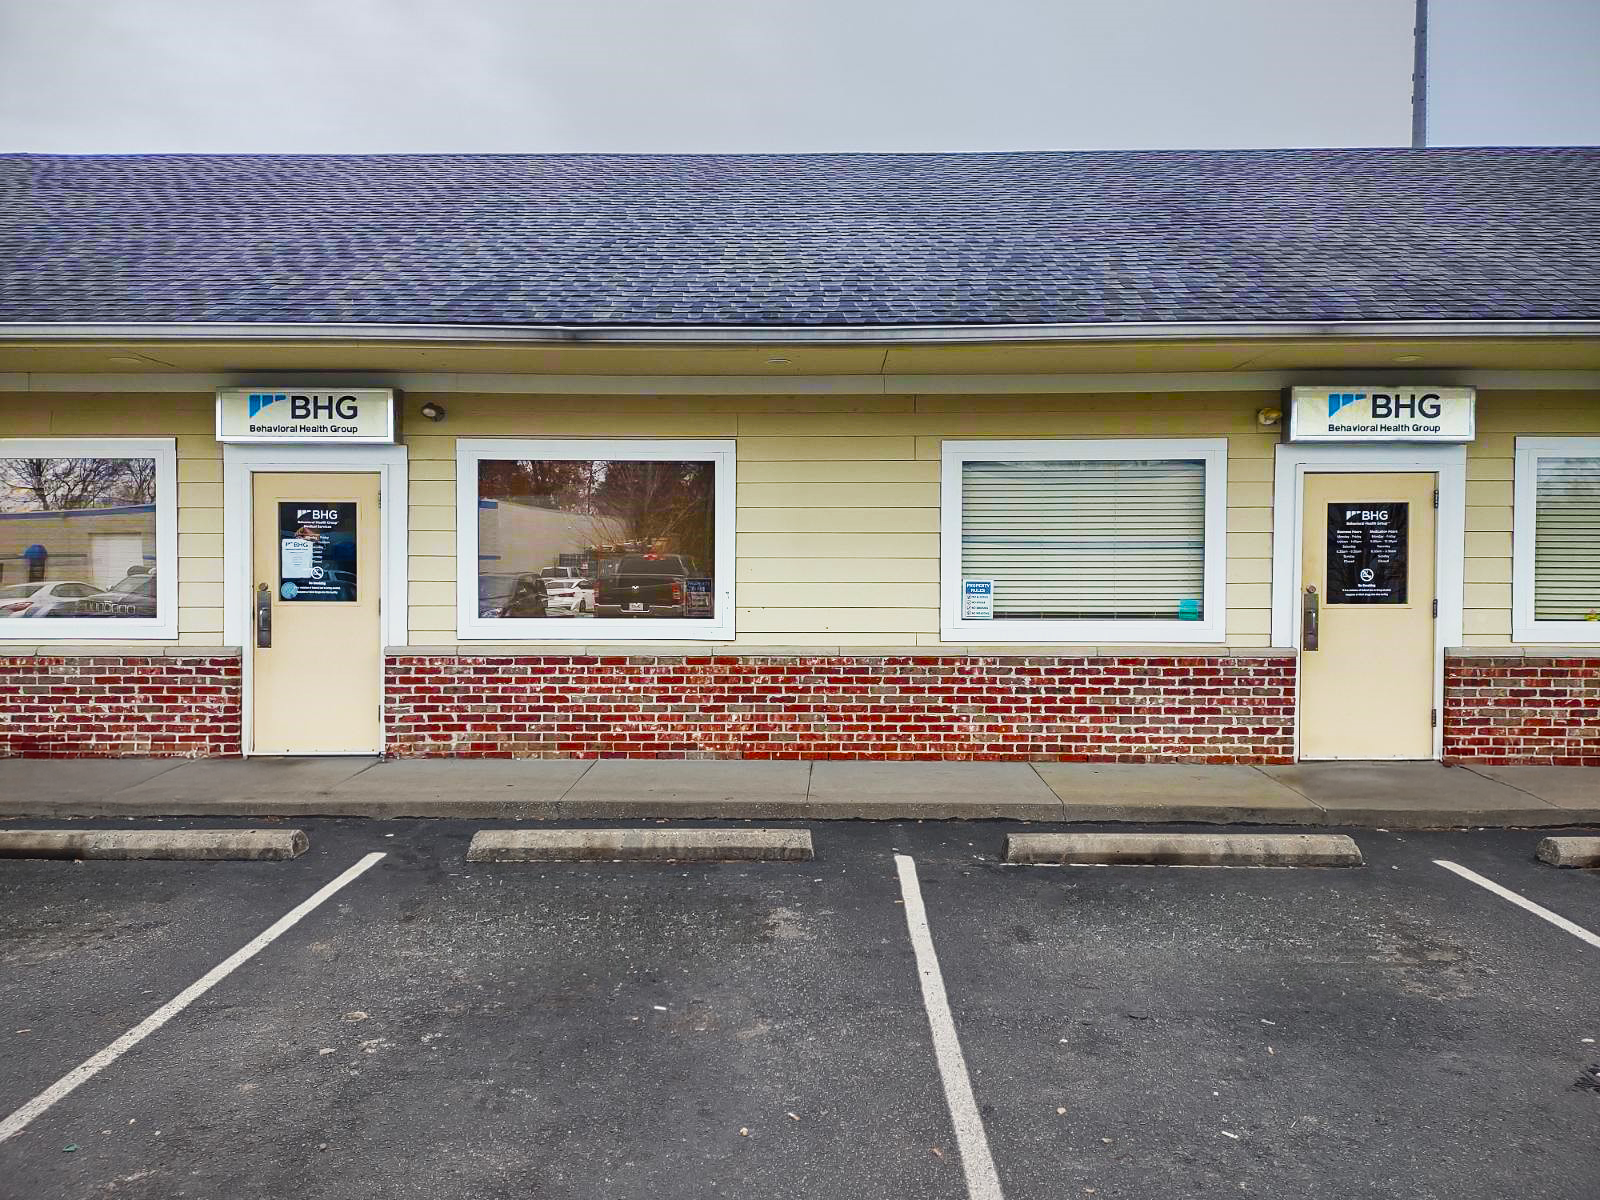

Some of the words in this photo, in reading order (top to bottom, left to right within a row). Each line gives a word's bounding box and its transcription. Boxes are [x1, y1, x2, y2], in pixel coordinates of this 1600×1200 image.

[291, 395, 359, 420] BHG
[1371, 393, 1442, 419] BHG
[249, 424, 298, 433] Behavioral
[300, 424, 329, 433] Health
[330, 424, 358, 434] Group
[1328, 424, 1378, 432] Behavioral
[1380, 423, 1410, 432] Health
[1412, 424, 1441, 434] Group
[312, 510, 338, 520] BHG
[1361, 511, 1389, 521] BHG
